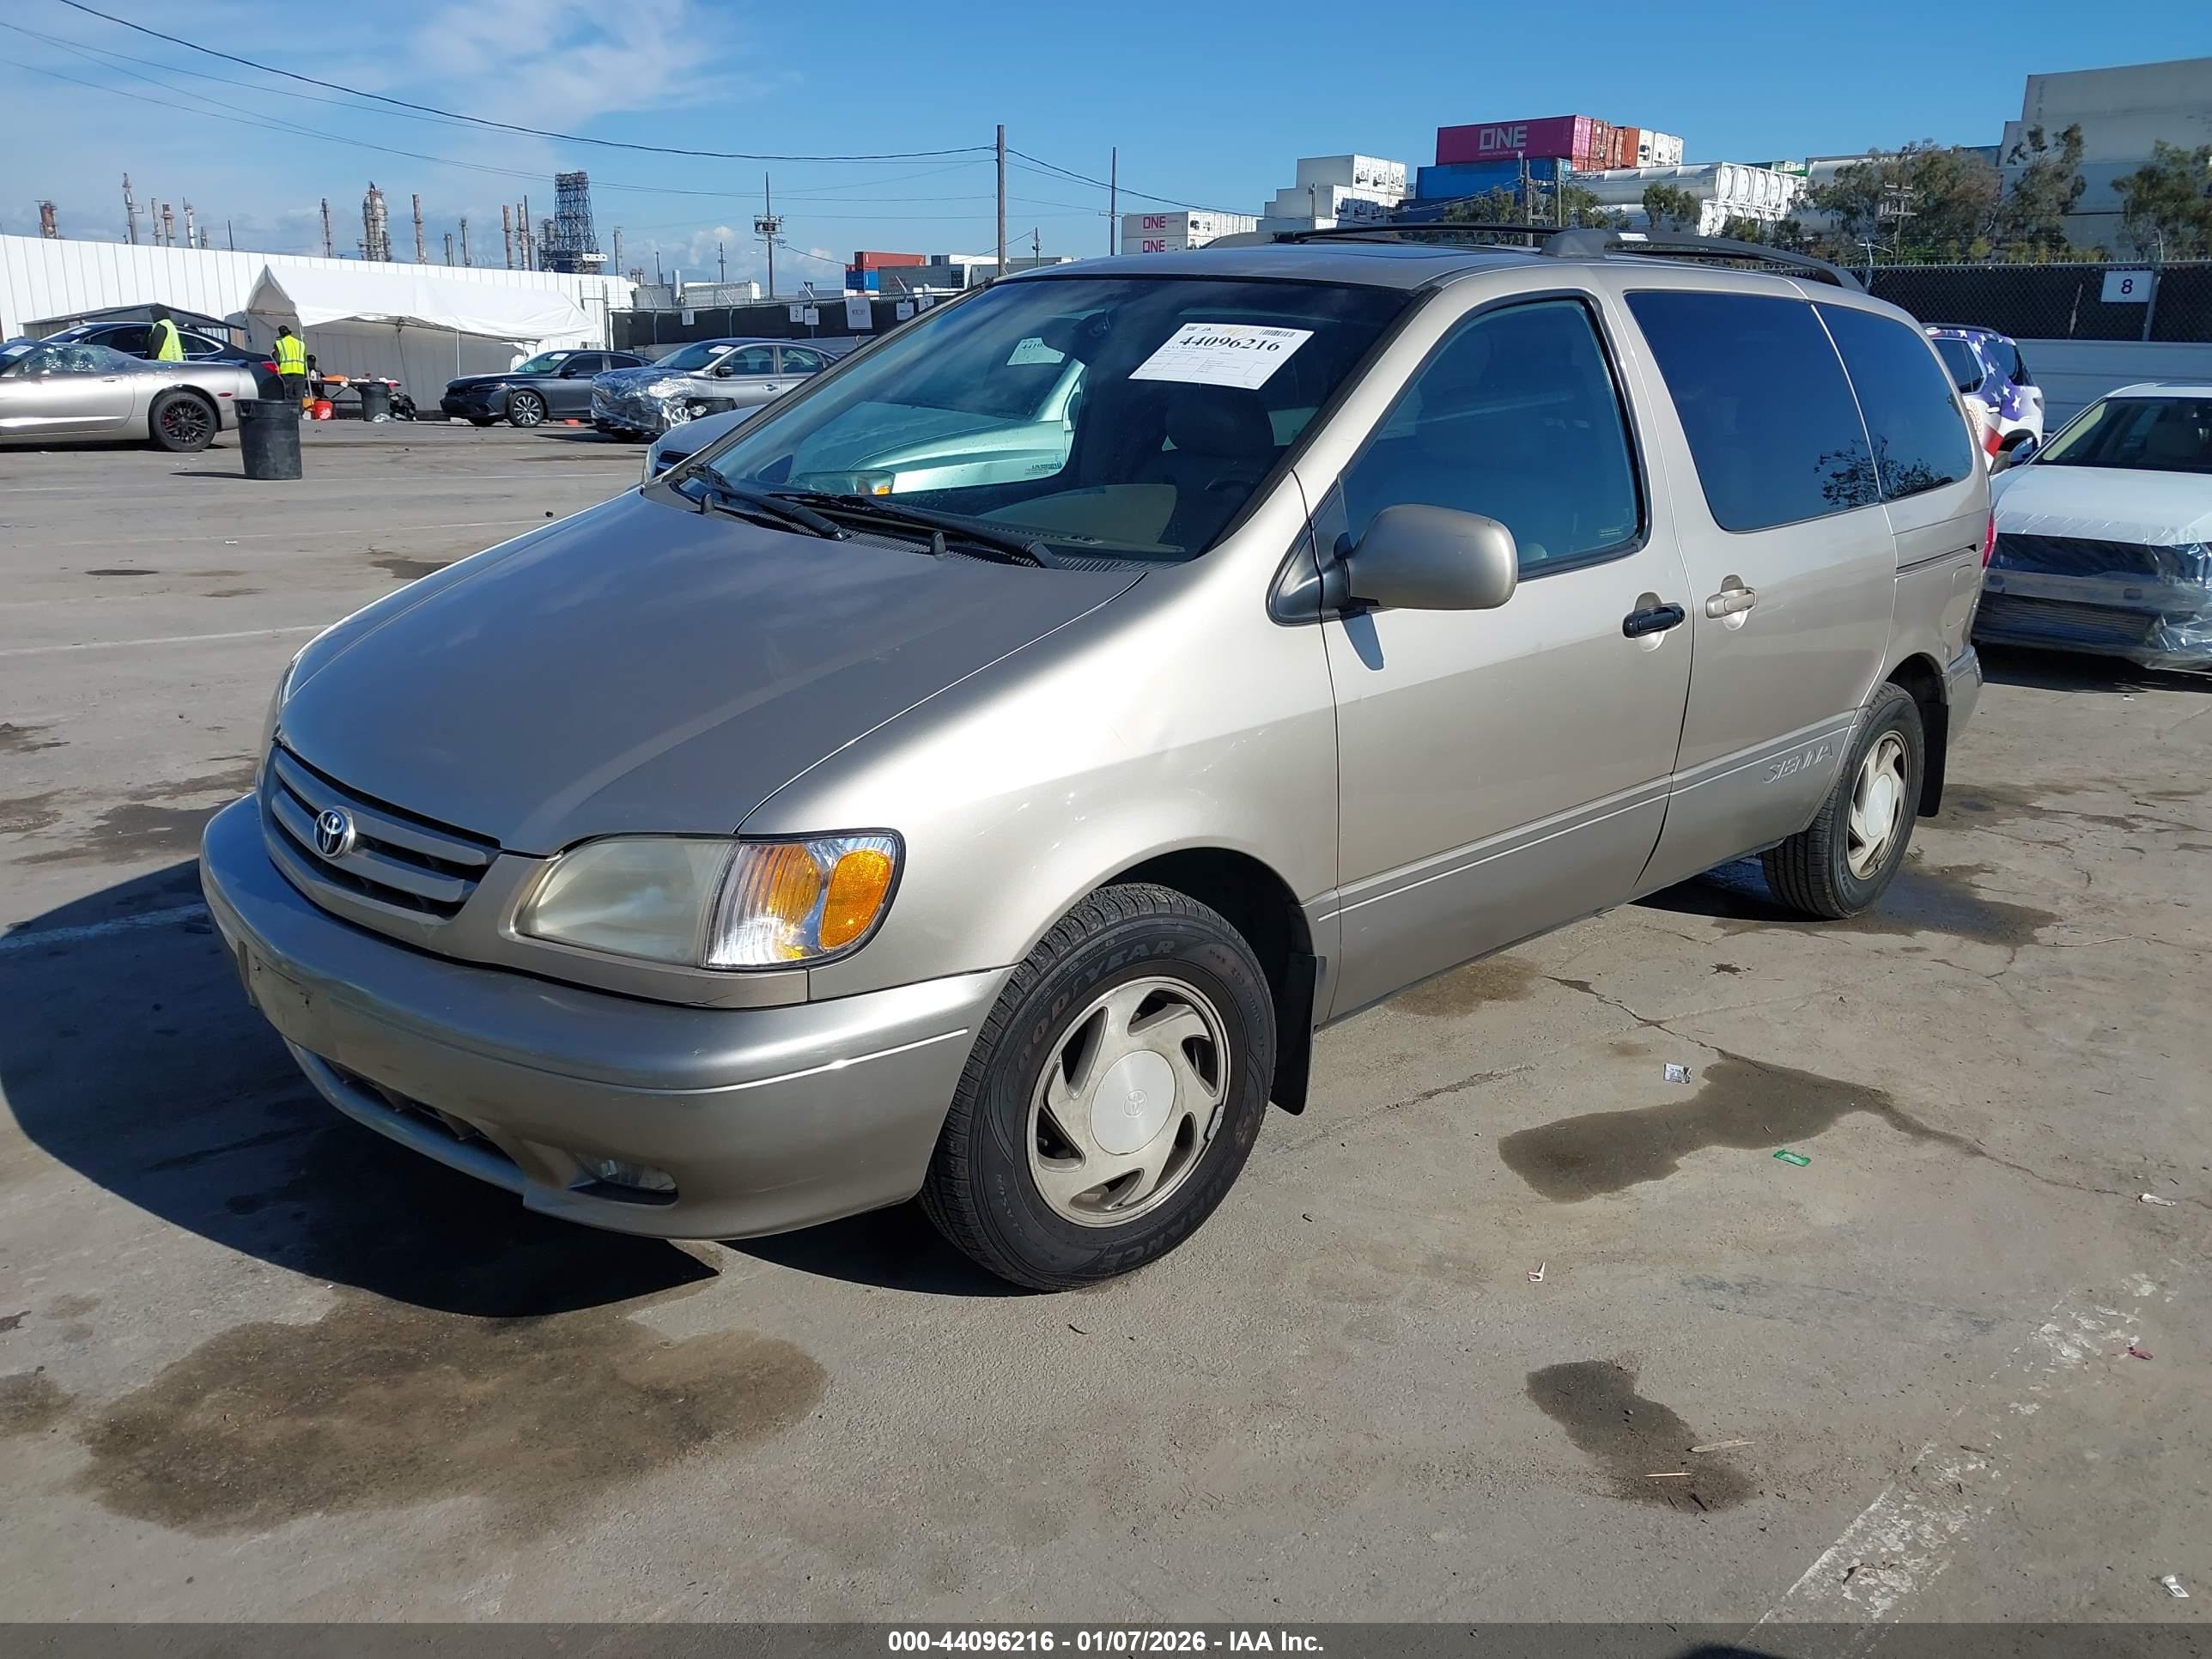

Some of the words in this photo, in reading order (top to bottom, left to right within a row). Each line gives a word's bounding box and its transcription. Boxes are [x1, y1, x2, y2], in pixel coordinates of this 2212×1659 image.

[1479, 125, 1528, 150] ONE
[1143, 216, 1166, 229] ONE
[1142, 240, 1165, 253] ONE
[2120, 278, 2134, 295] 8
[1179, 335, 1285, 352] 44096216
[1762, 742, 1833, 784] SIENNA
